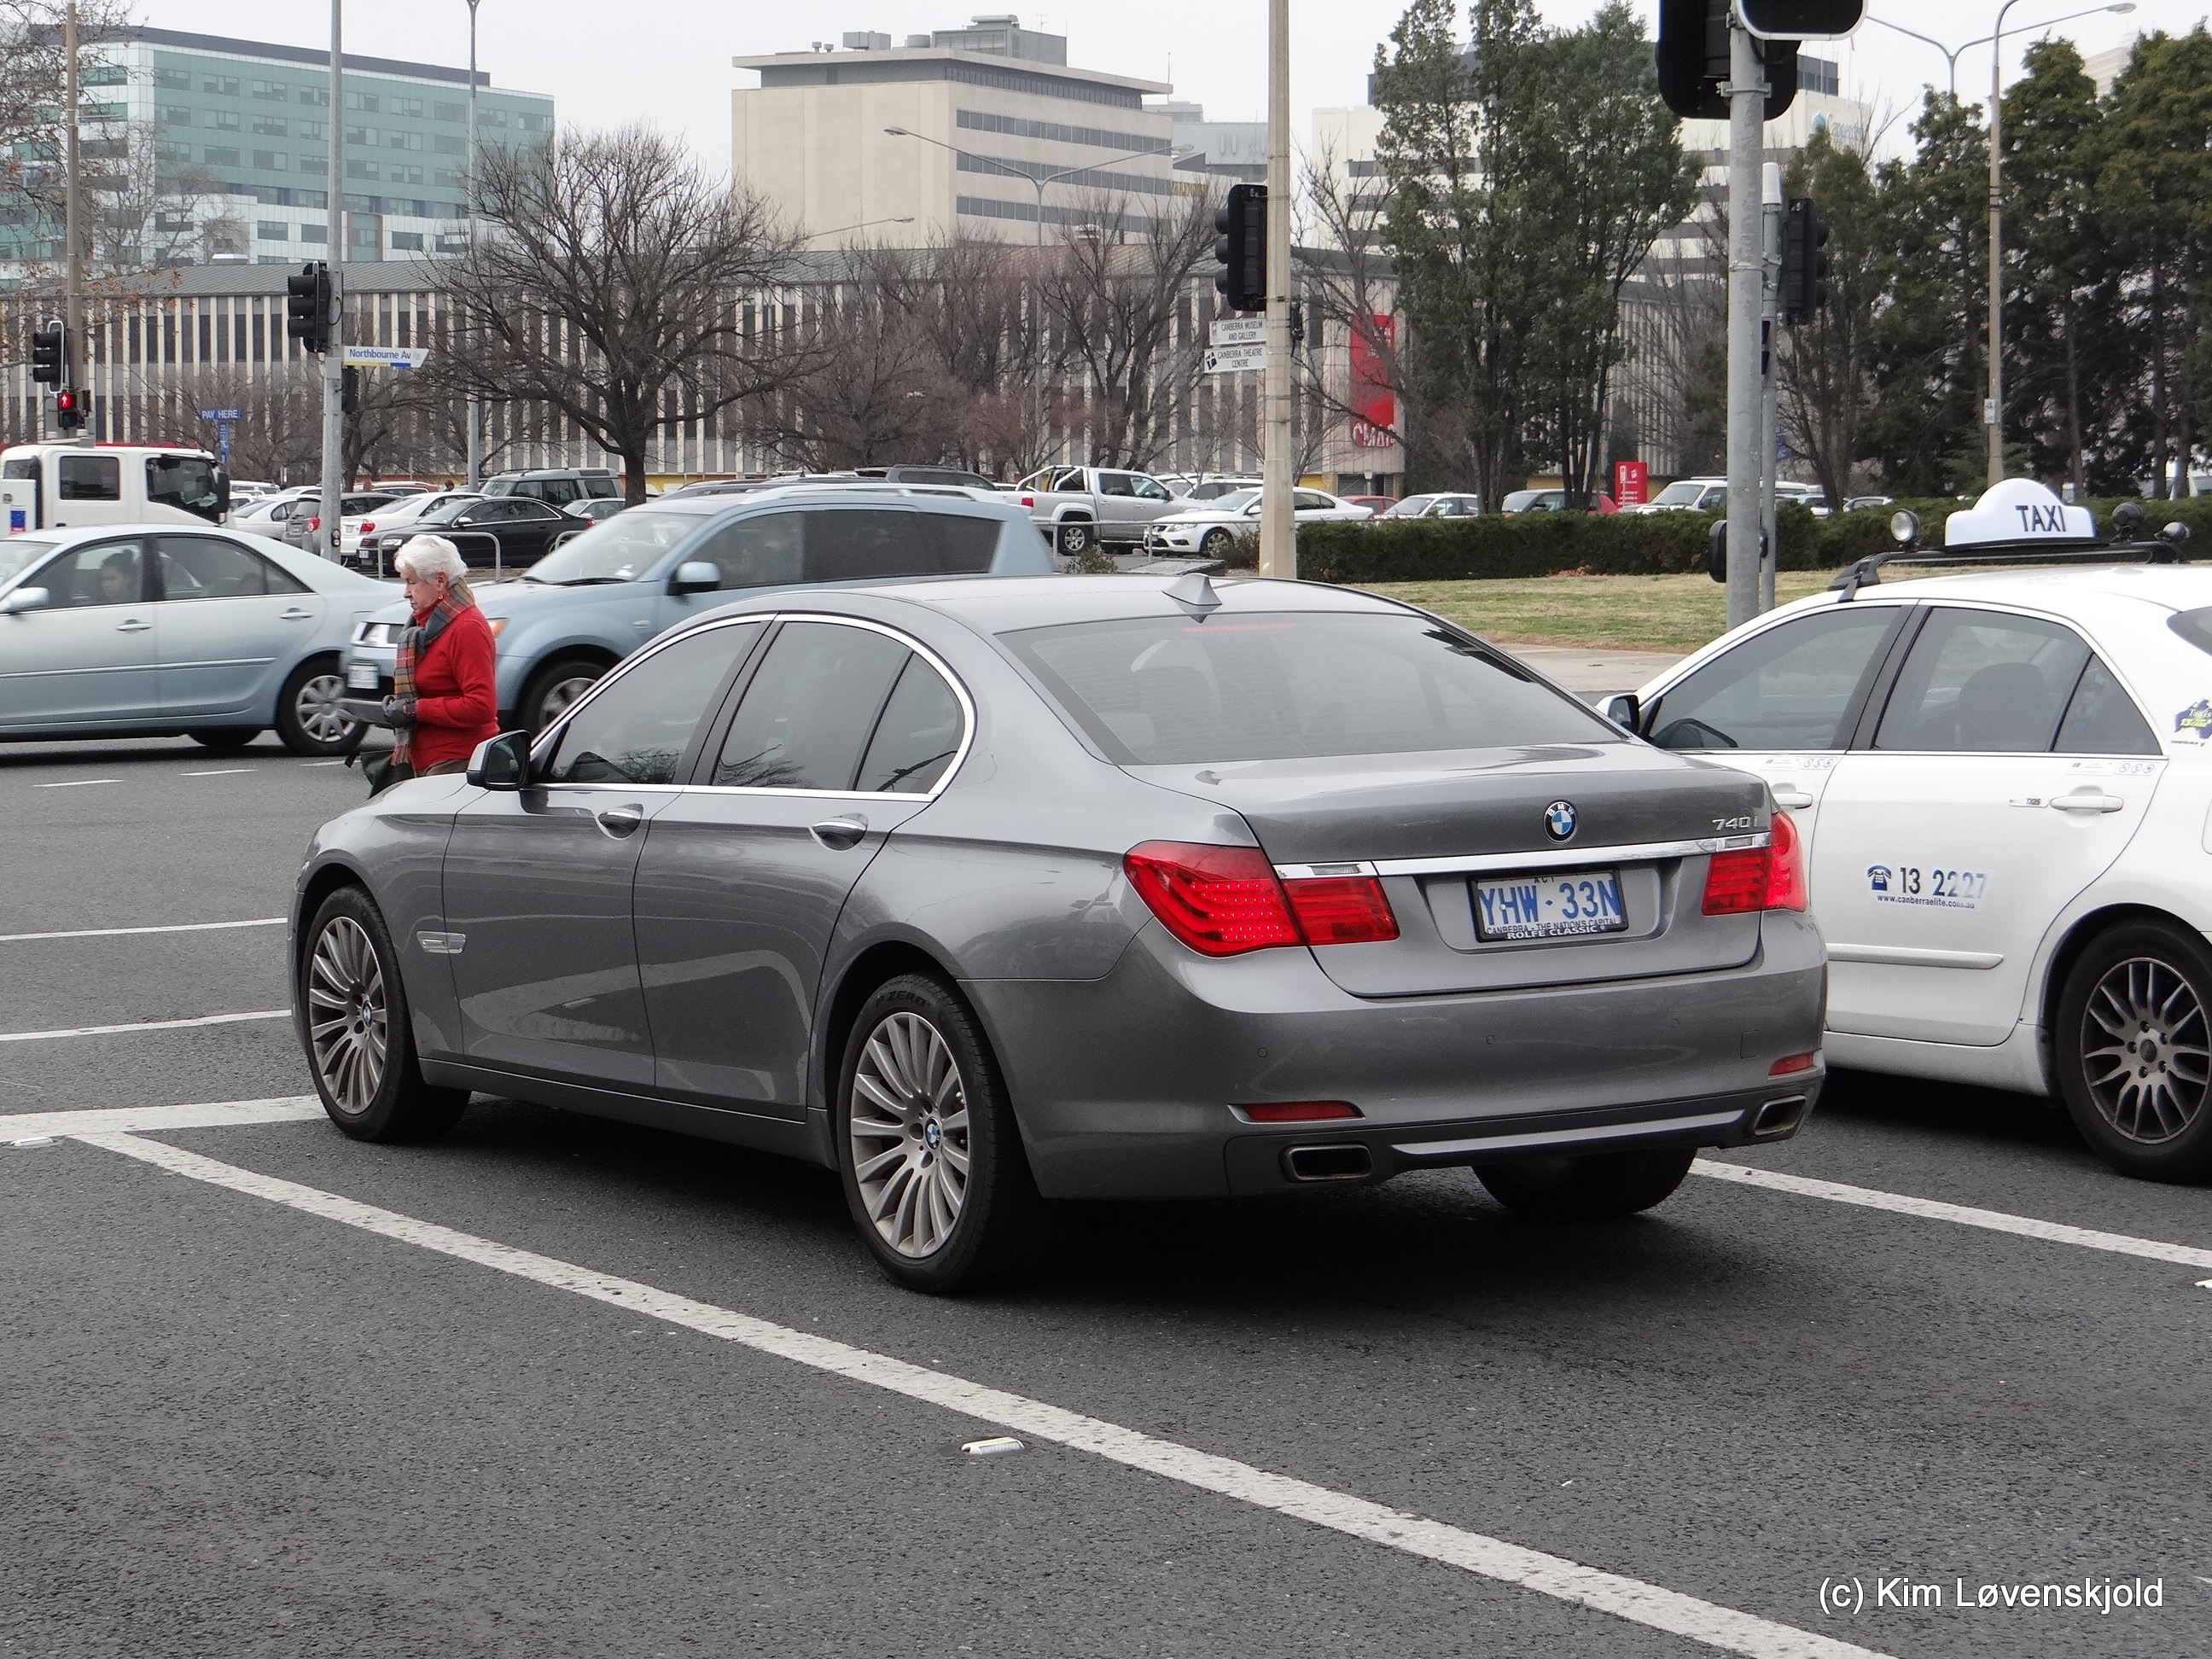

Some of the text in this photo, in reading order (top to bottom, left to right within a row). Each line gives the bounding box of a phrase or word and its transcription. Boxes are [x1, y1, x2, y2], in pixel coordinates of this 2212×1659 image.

[1221, 320, 1263, 331] CANBERRA MUSEUM
[1238, 331, 1256, 341] GALLERY
[349, 348, 411, 359] Northbourne Av
[1217, 347, 1263, 359] CANBERRA THEATRE
[1231, 358, 1249, 368] CENTRE
[201, 410, 239, 419] PAY HERE
[2015, 505, 2066, 533] TAXI
[1547, 803, 1575, 817] BMW
[1711, 816, 1758, 831] 740i
[1900, 867, 1986, 899] 13 2227
[1877, 895, 1975, 909] www.canberraelite.com.au
[1487, 924, 1529, 935] CANBERRA
[1536, 922, 1551, 931] THE
[1588, 917, 1617, 927] CAPITAL
[1507, 926, 1598, 940] ROLFE CLASSIC
[887, 990, 927, 1007] ZERO
